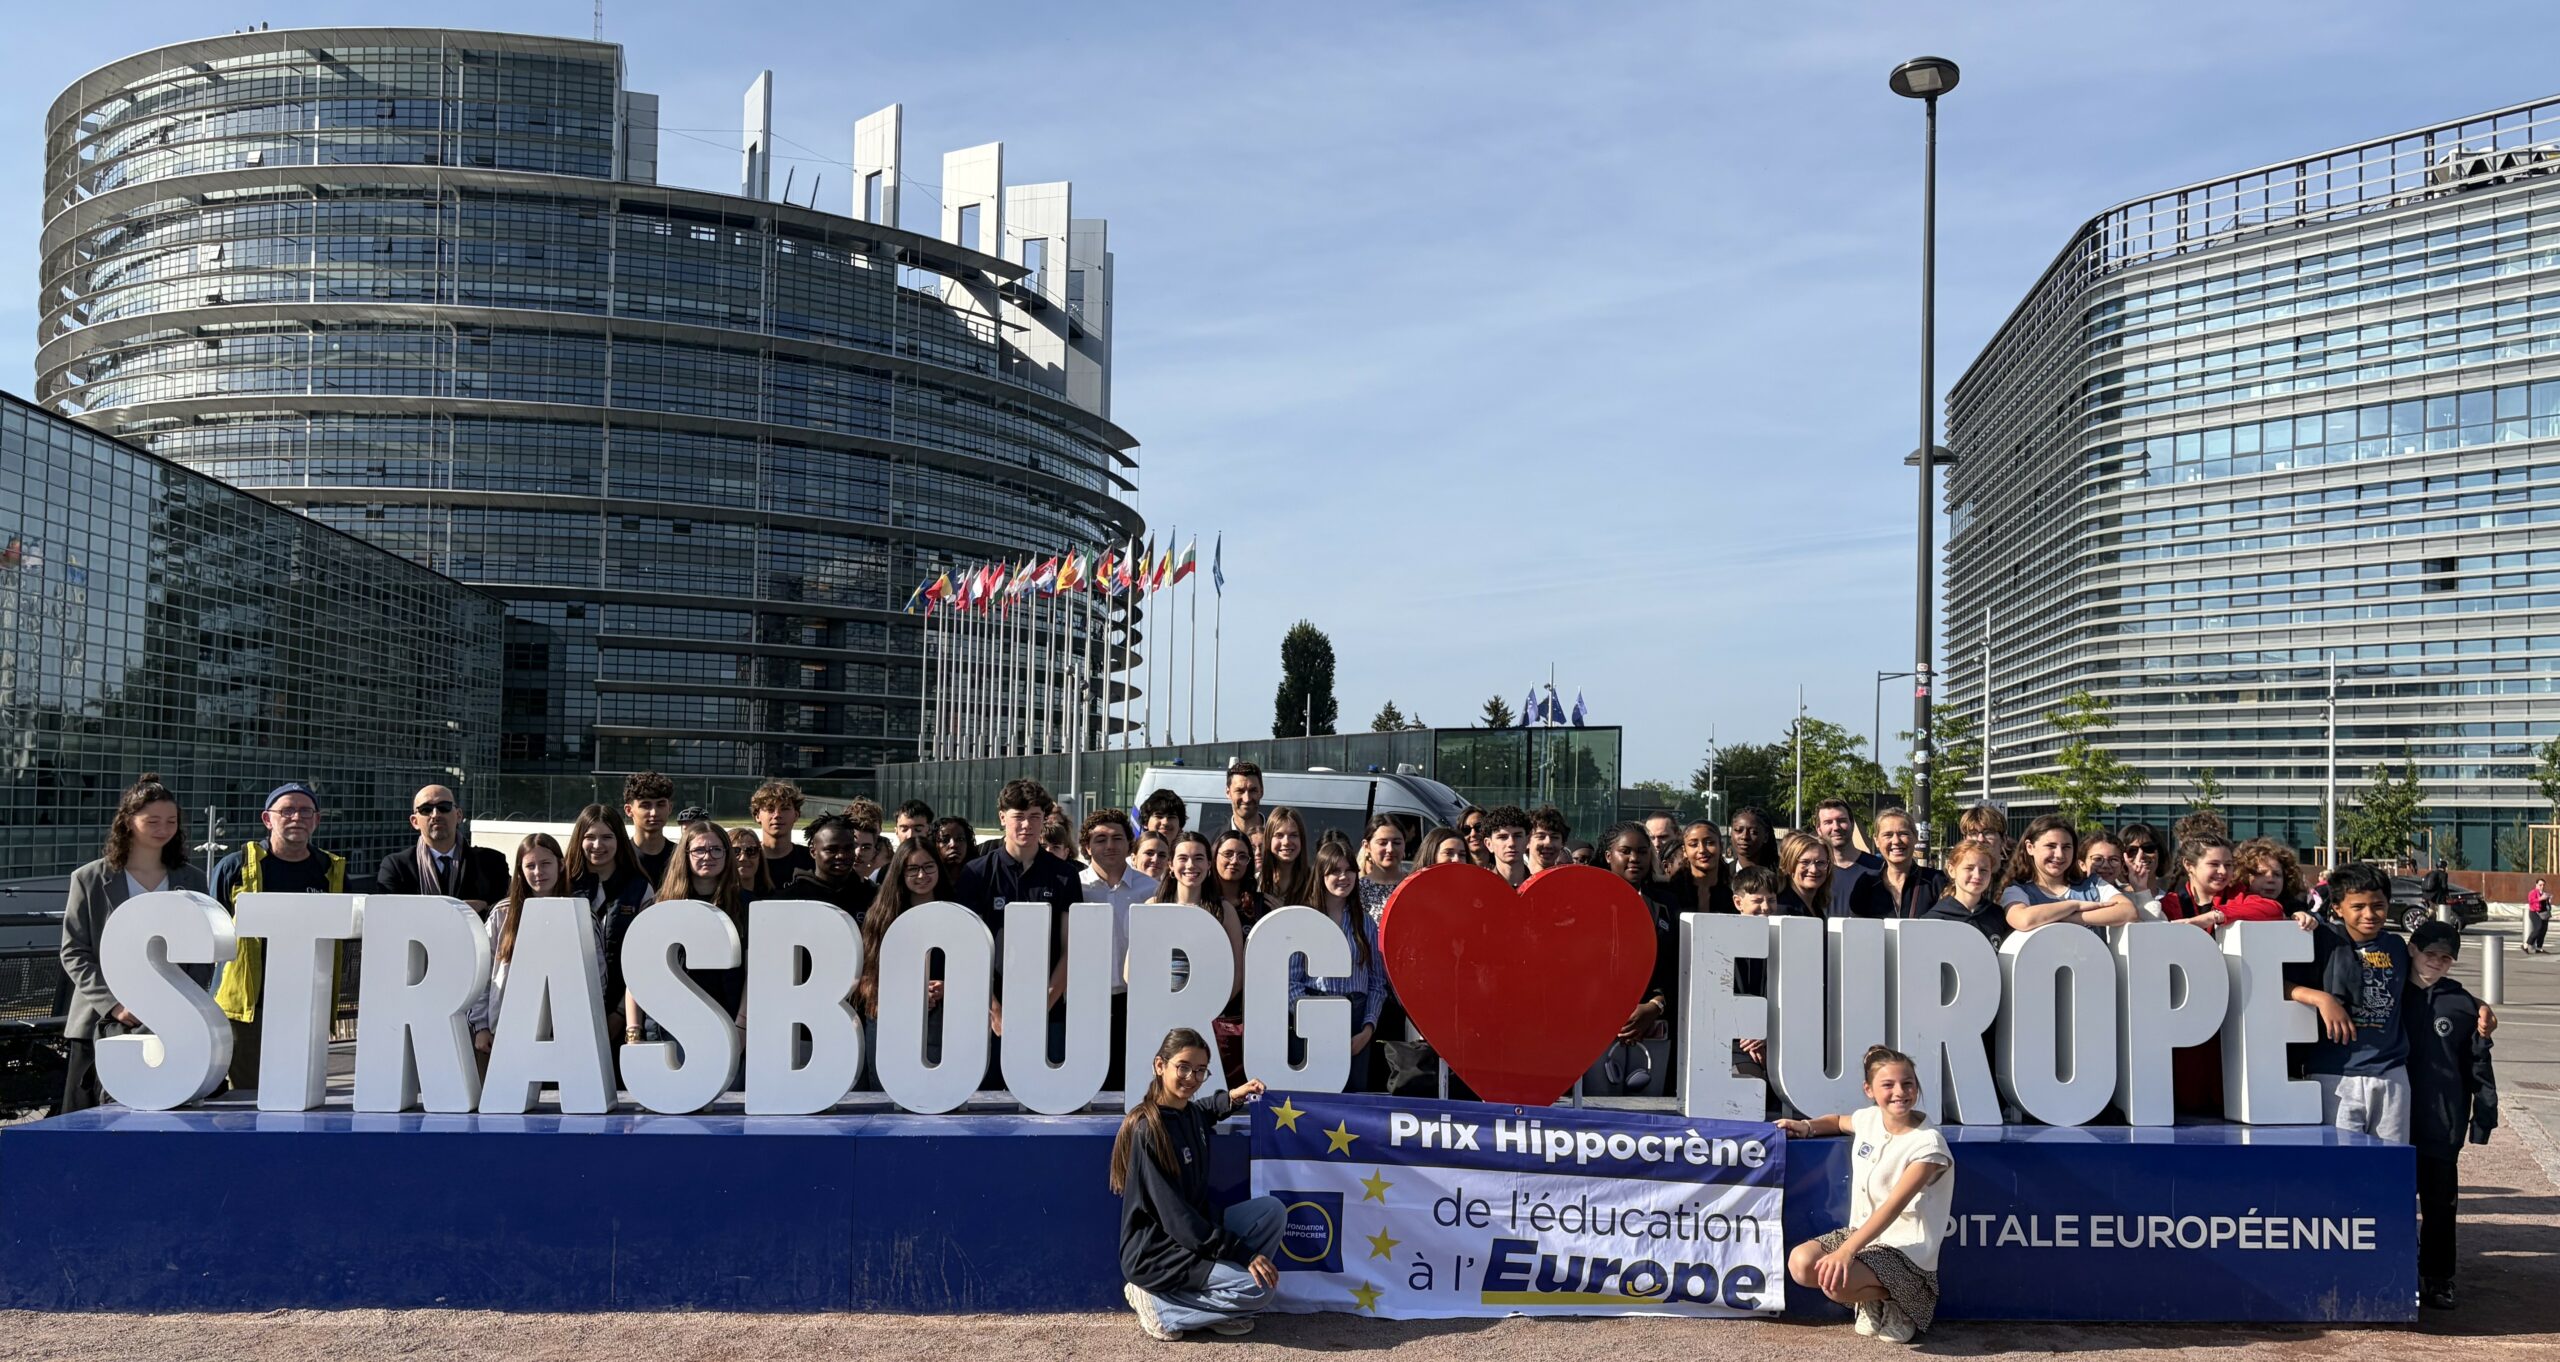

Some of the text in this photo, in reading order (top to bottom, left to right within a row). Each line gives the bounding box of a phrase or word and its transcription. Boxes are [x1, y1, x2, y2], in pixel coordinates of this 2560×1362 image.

[95, 890, 2323, 1126] STRASBOURG EUROPE
[1390, 1112, 1767, 1169] Prix Hippocrène
[1287, 1223, 1325, 1231] FONDATION
[1433, 1187, 1761, 1244] de l'éducation
[2090, 1207, 2376, 1250] EUROPÉENNE
[1408, 1252, 1433, 1291] à
